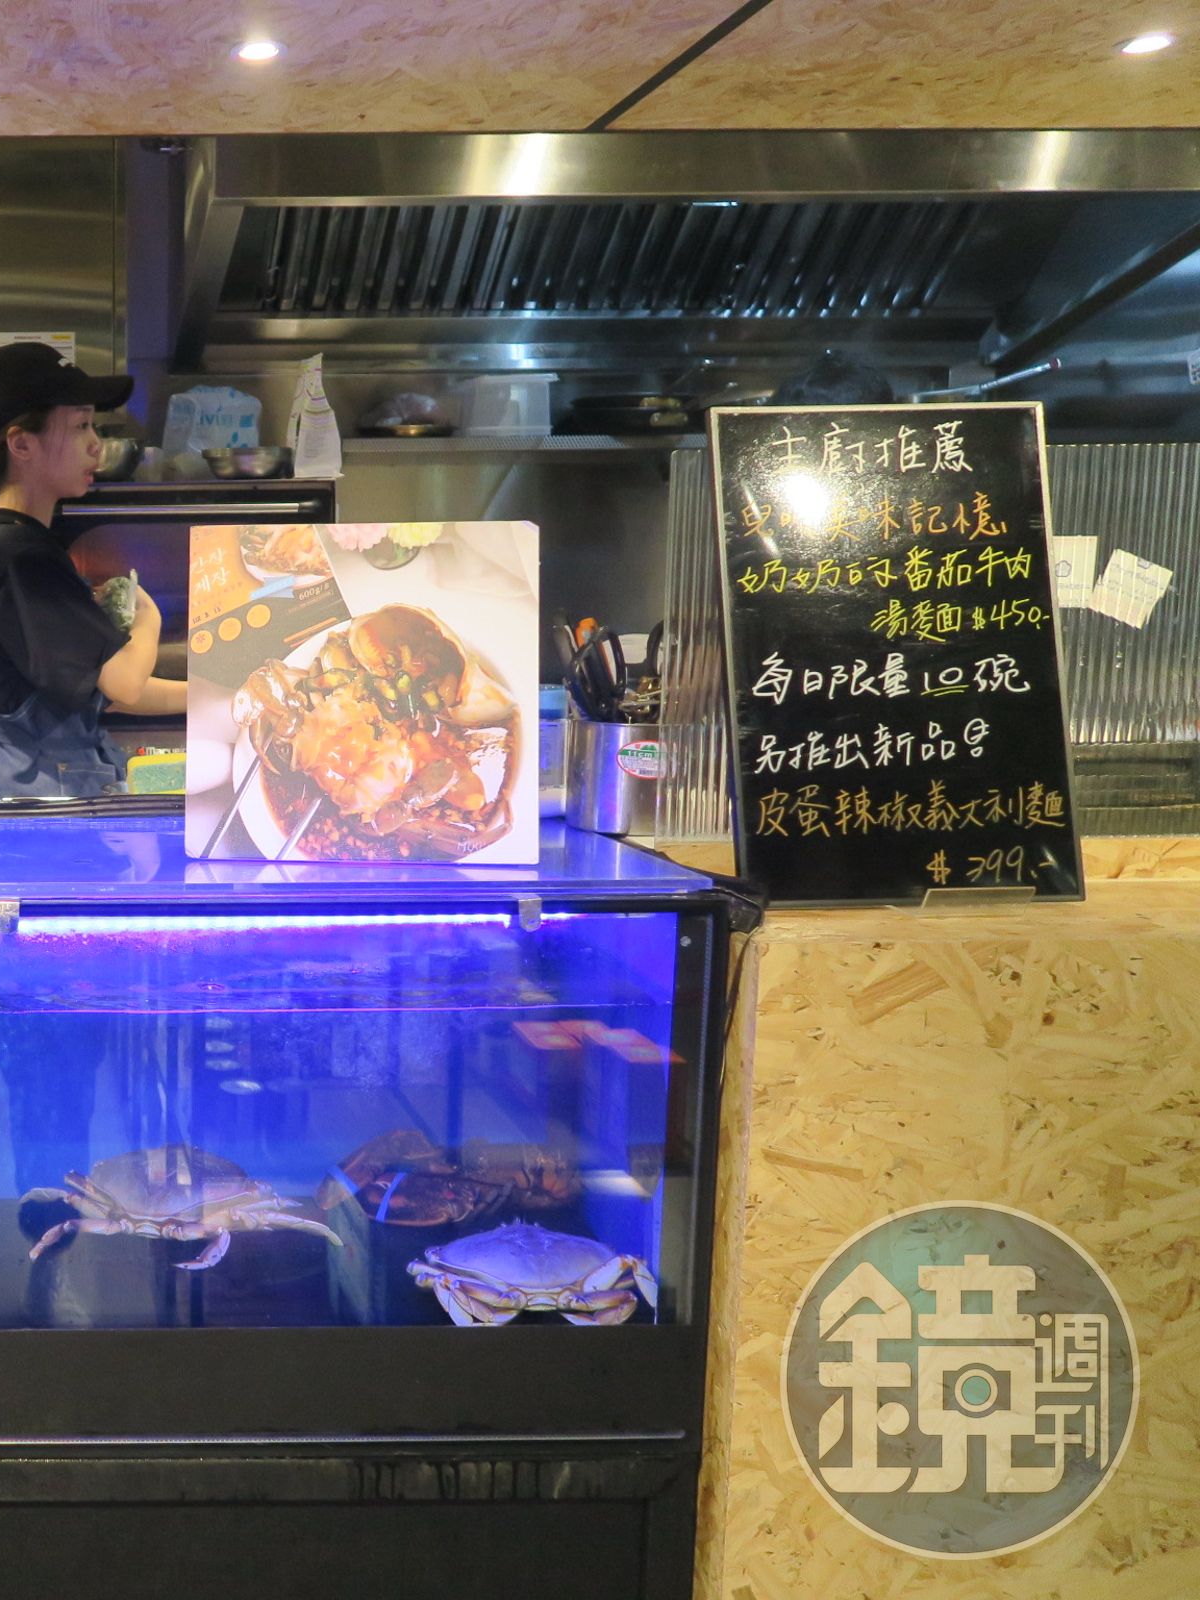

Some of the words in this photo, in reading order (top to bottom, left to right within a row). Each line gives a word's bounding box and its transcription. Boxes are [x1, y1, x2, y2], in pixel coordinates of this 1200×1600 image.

[737, 546, 1032, 594] 奶奶的番茄牛肉
[752, 651, 1031, 705] 每日限量10碗
